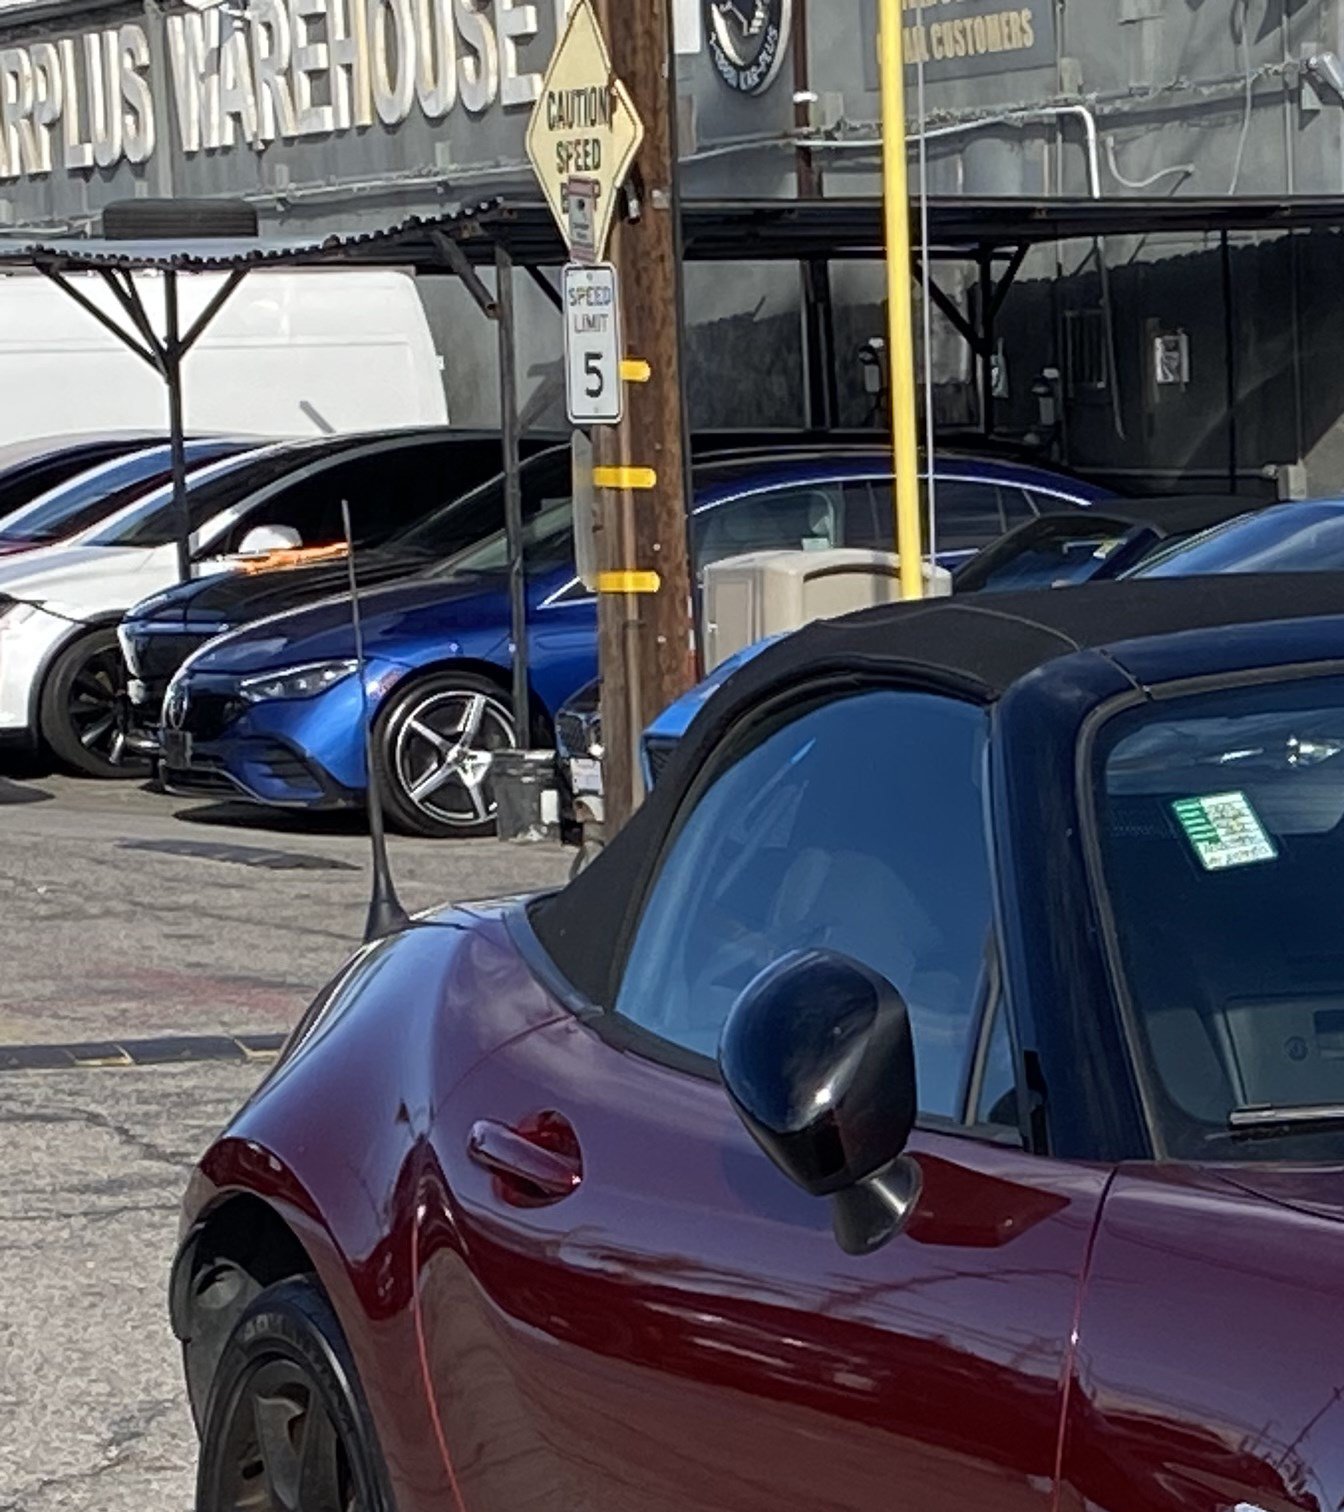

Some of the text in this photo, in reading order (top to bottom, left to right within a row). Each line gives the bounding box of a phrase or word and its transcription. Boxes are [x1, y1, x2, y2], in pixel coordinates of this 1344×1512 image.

[930, 7, 1035, 61] CUSTOMERS
[166, 0, 545, 152] WAREHOUSE
[546, 86, 613, 132] CAUTION
[556, 138, 601, 174] SPEED
[568, 286, 611, 307] SPEED
[574, 313, 609, 333] LIMIT
[584, 351, 604, 398] 5
